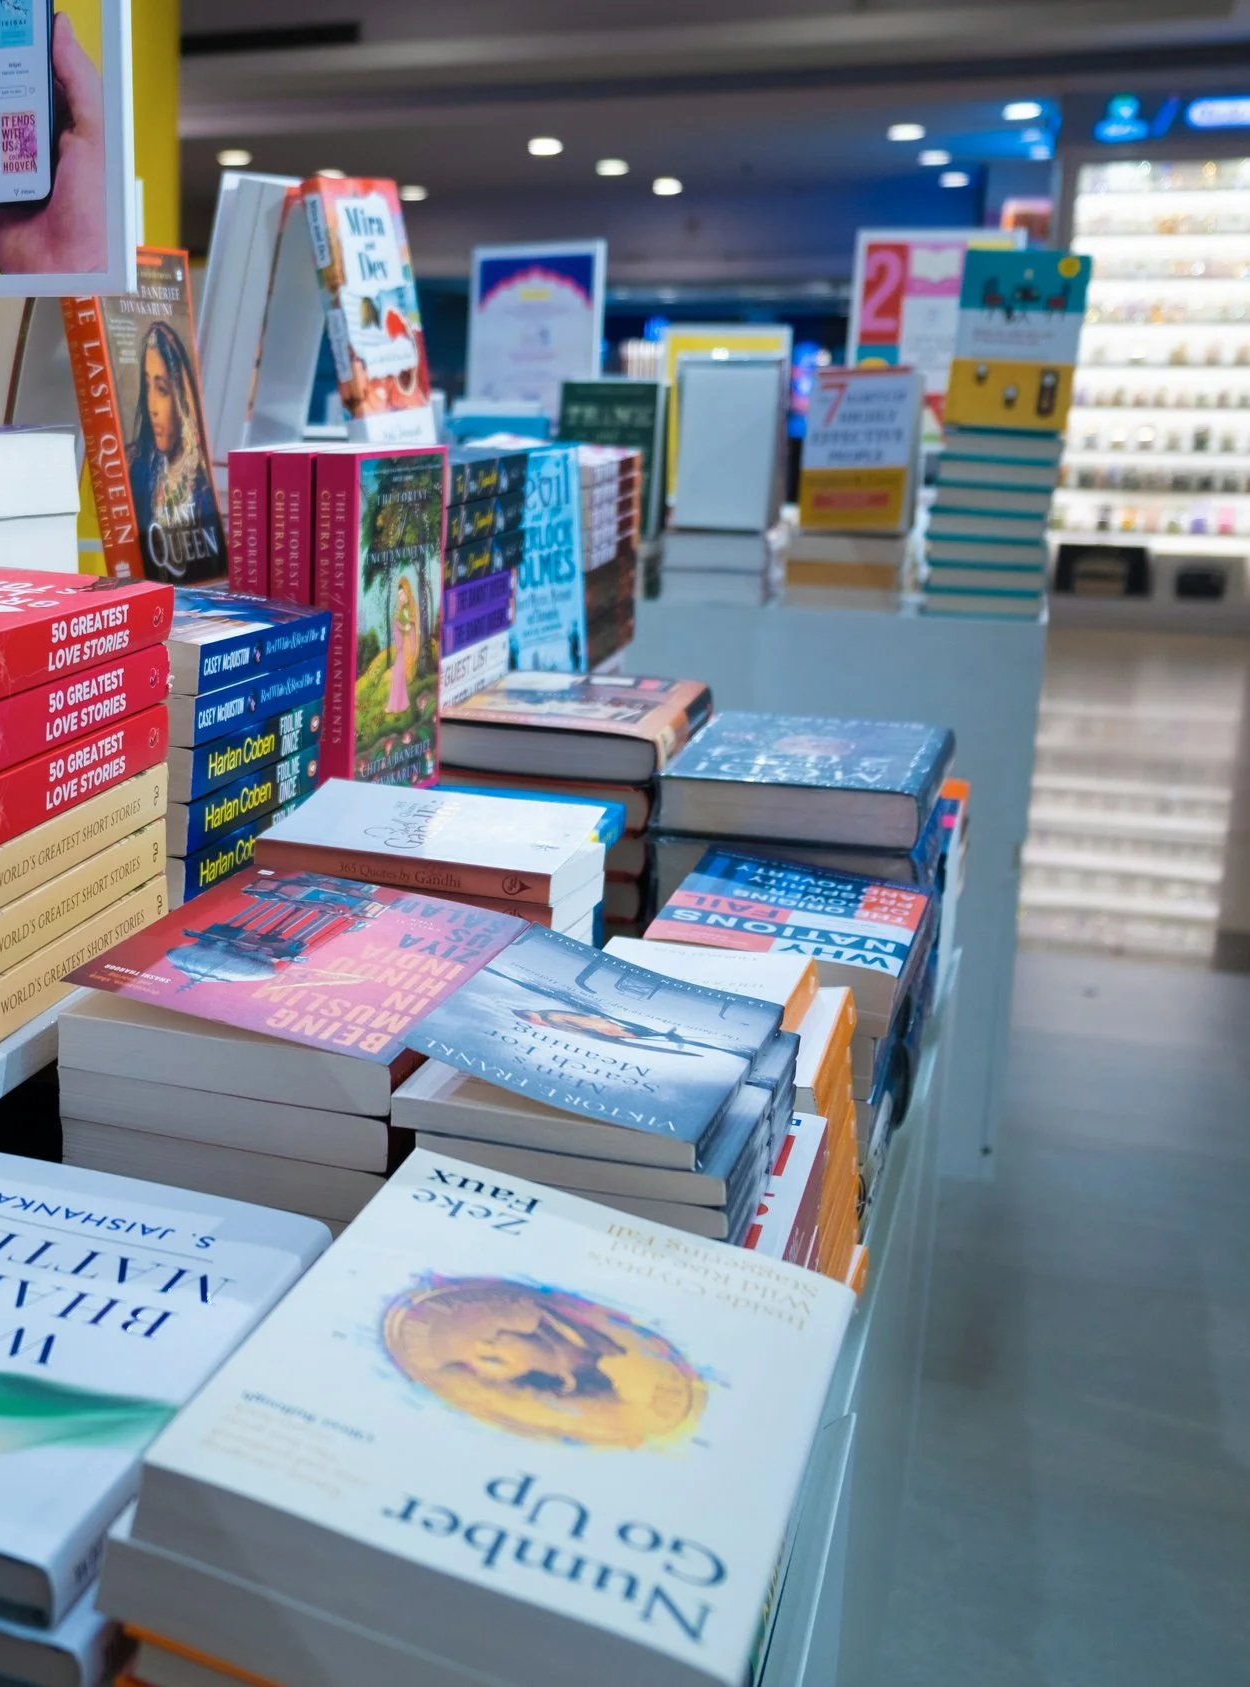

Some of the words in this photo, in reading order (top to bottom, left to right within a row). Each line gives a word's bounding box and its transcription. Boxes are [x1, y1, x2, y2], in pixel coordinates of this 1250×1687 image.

[1, 116, 9, 127] IT
[11, 114, 36, 127] ENDS
[2, 128, 25, 140] WITH
[2, 140, 14, 152] US
[344, 207, 385, 237] Mira
[358, 252, 388, 281] Dev
[82, 340, 113, 418] LAST
[99, 433, 134, 545] QUEEN
[163, 501, 196, 529] LAST
[232, 488, 243, 551] CHITRA
[247, 488, 258, 520] THE
[274, 490, 285, 551] CHITRA
[289, 490, 300, 522] THE
[320, 490, 330, 551] CHITRA
[335, 490, 346, 522] THE
[147, 522, 220, 577] QUEEN
[247, 523, 258, 587] FOREST
[288, 526, 299, 588] FOREST
[334, 526, 345, 590] FOREST
[51, 621, 67, 644] 50
[70, 604, 129, 638] GREATEST
[48, 645, 81, 672] LOVE
[83, 630, 130, 655] STORIES
[203, 657, 222, 677] CASEY
[444, 655, 472, 687] GUEST
[472, 645, 489, 672] LIST
[49, 691, 65, 713] 50
[67, 668, 125, 707] GREATEST
[331, 611, 343, 745] ENCHANTMENTS
[46, 713, 78, 741] LOVE
[80, 693, 127, 728] STORIES
[198, 710, 216, 730] CASEY
[279, 714, 295, 736] FOOL
[295, 709, 304, 728] ME
[49, 760, 65, 782] 50
[67, 731, 125, 773] GREATEST
[208, 744, 243, 780] Harlan
[243, 733, 275, 764] Coben
[281, 730, 300, 757] ONCE
[45, 781, 78, 810] LOVE
[80, 756, 126, 797] STORIES
[276, 762, 291, 783] FOOL
[291, 755, 300, 775] ME
[204, 796, 239, 833] Harlan
[239, 781, 272, 813] Coben
[278, 777, 297, 804] ONCE
[38, 831, 80, 866] GREATEST
[82, 815, 109, 841] SHORT
[111, 798, 141, 827] STORIES
[199, 851, 234, 887] Harlan
[338, 861, 357, 873] 365
[359, 865, 398, 880] Quotes
[400, 869, 411, 881] by
[415, 870, 462, 889] Gandhi
[735, 864, 853, 891] POVERTY
[38, 894, 80, 929] GREATEST
[82, 875, 109, 902] SHORT
[110, 856, 141, 885] STORIES
[683, 894, 779, 919] FAIL
[732, 889, 847, 915] ORIGINS
[391, 899, 507, 934] SALAM
[671, 908, 897, 954] NATIONS
[398, 933, 481, 964] ZIYA
[445, 928, 495, 949] US
[778, 944, 890, 970] WHY
[0, 978, 42, 1015] WORLD'S
[44, 949, 86, 988] GREATEST
[87, 930, 114, 957] SHORT
[115, 909, 145, 940] STORIES
[104, 963, 140, 977] THAROOR
[140, 971, 171, 984] SHASHI
[360, 943, 466, 981] INDIA
[251, 981, 412, 1034] MUSLIM
[382, 990, 431, 1015] IN
[265, 1010, 393, 1055] BEING
[483, 1029, 535, 1054] For
[510, 1021, 652, 1077] Meaning
[425, 1035, 527, 1088] FRANKL
[513, 1056, 606, 1096] Man's
[552, 1053, 660, 1094] Search
[564, 1092, 676, 1133] VIKTOR
[428, 1166, 543, 1216] Faux
[412, 1188, 532, 1236] Zeke
[191, 1232, 216, 1250] S.
[606, 1222, 657, 1249] Fall
[608, 1238, 668, 1266] and
[665, 1237, 819, 1299] Staggering
[669, 1258, 732, 1290] Rise
[712, 1293, 808, 1332] Inside
[739, 1278, 812, 1315] Wild
[485, 1471, 590, 1543] Up
[381, 1494, 717, 1645] Number
[615, 1519, 728, 1589] Go
